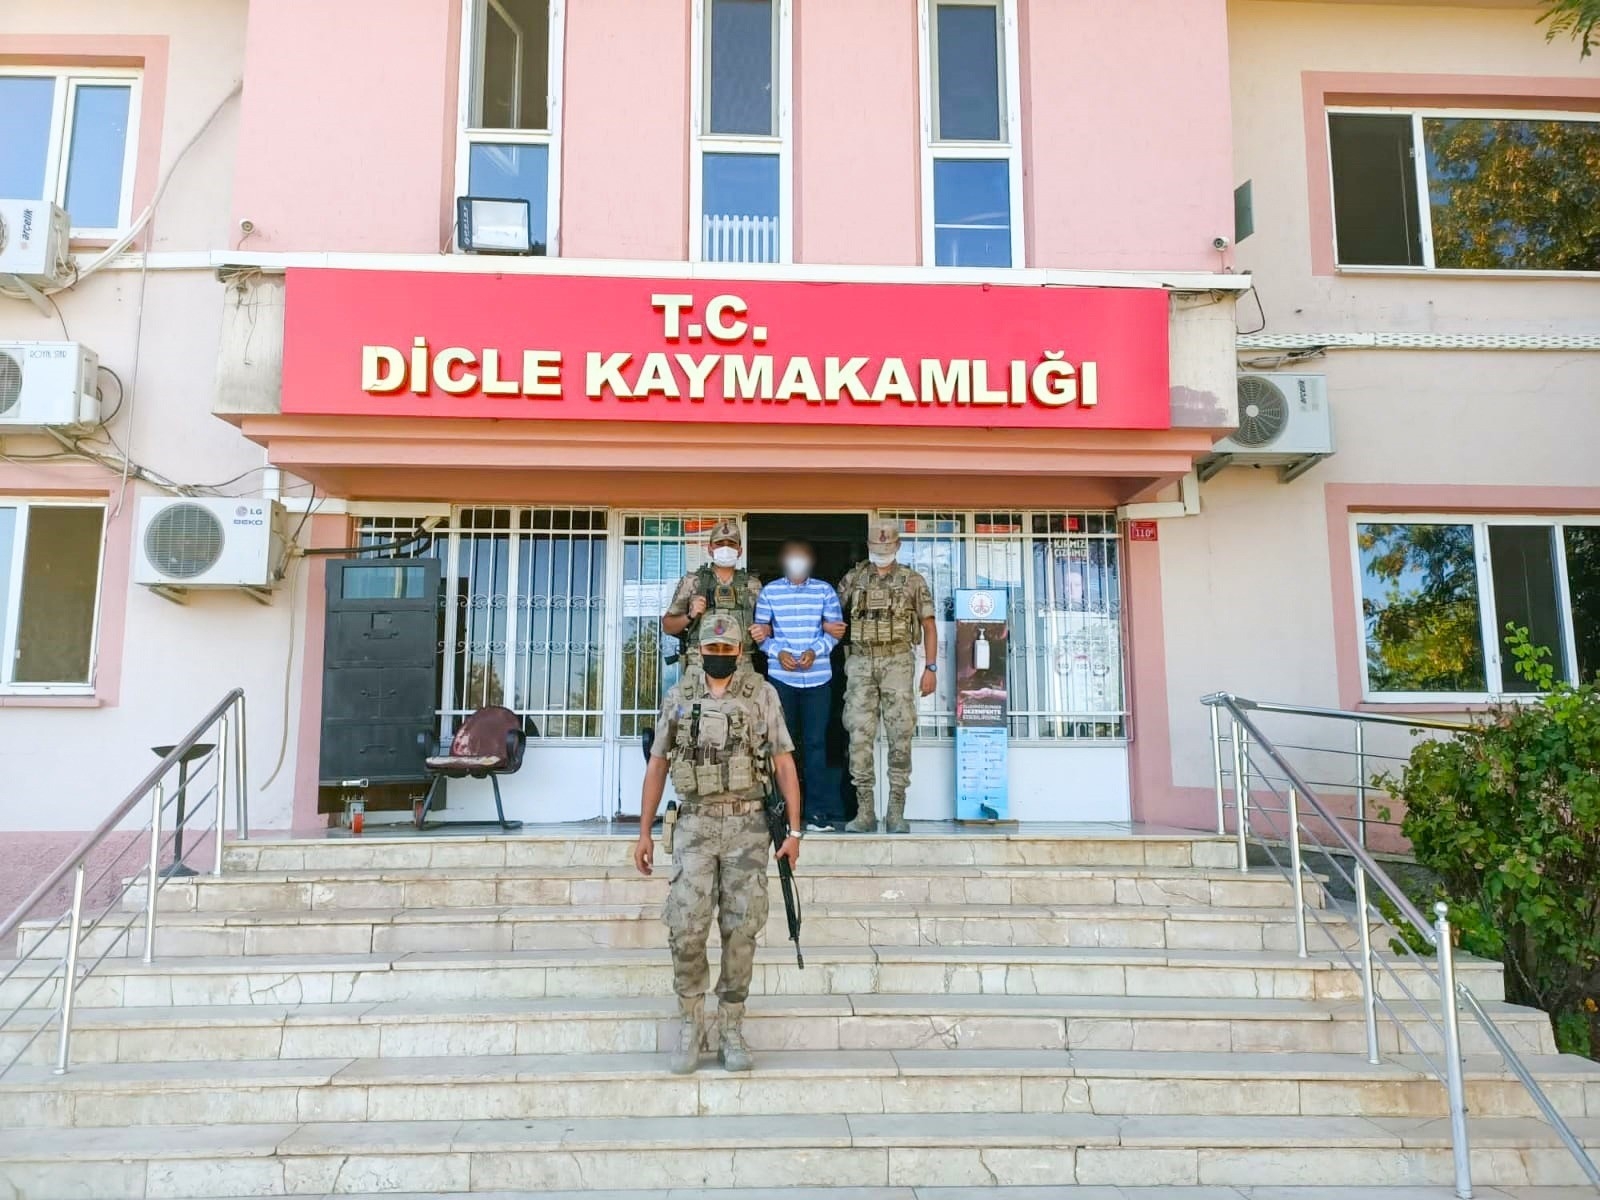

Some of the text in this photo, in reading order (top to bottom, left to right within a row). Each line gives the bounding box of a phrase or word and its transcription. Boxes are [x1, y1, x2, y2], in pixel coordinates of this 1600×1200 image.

[650, 292, 769, 343] T.C.
[361, 336, 1100, 407] DİCLE KAYMAKAMLIĞI
[250, 507, 263, 516] LG
